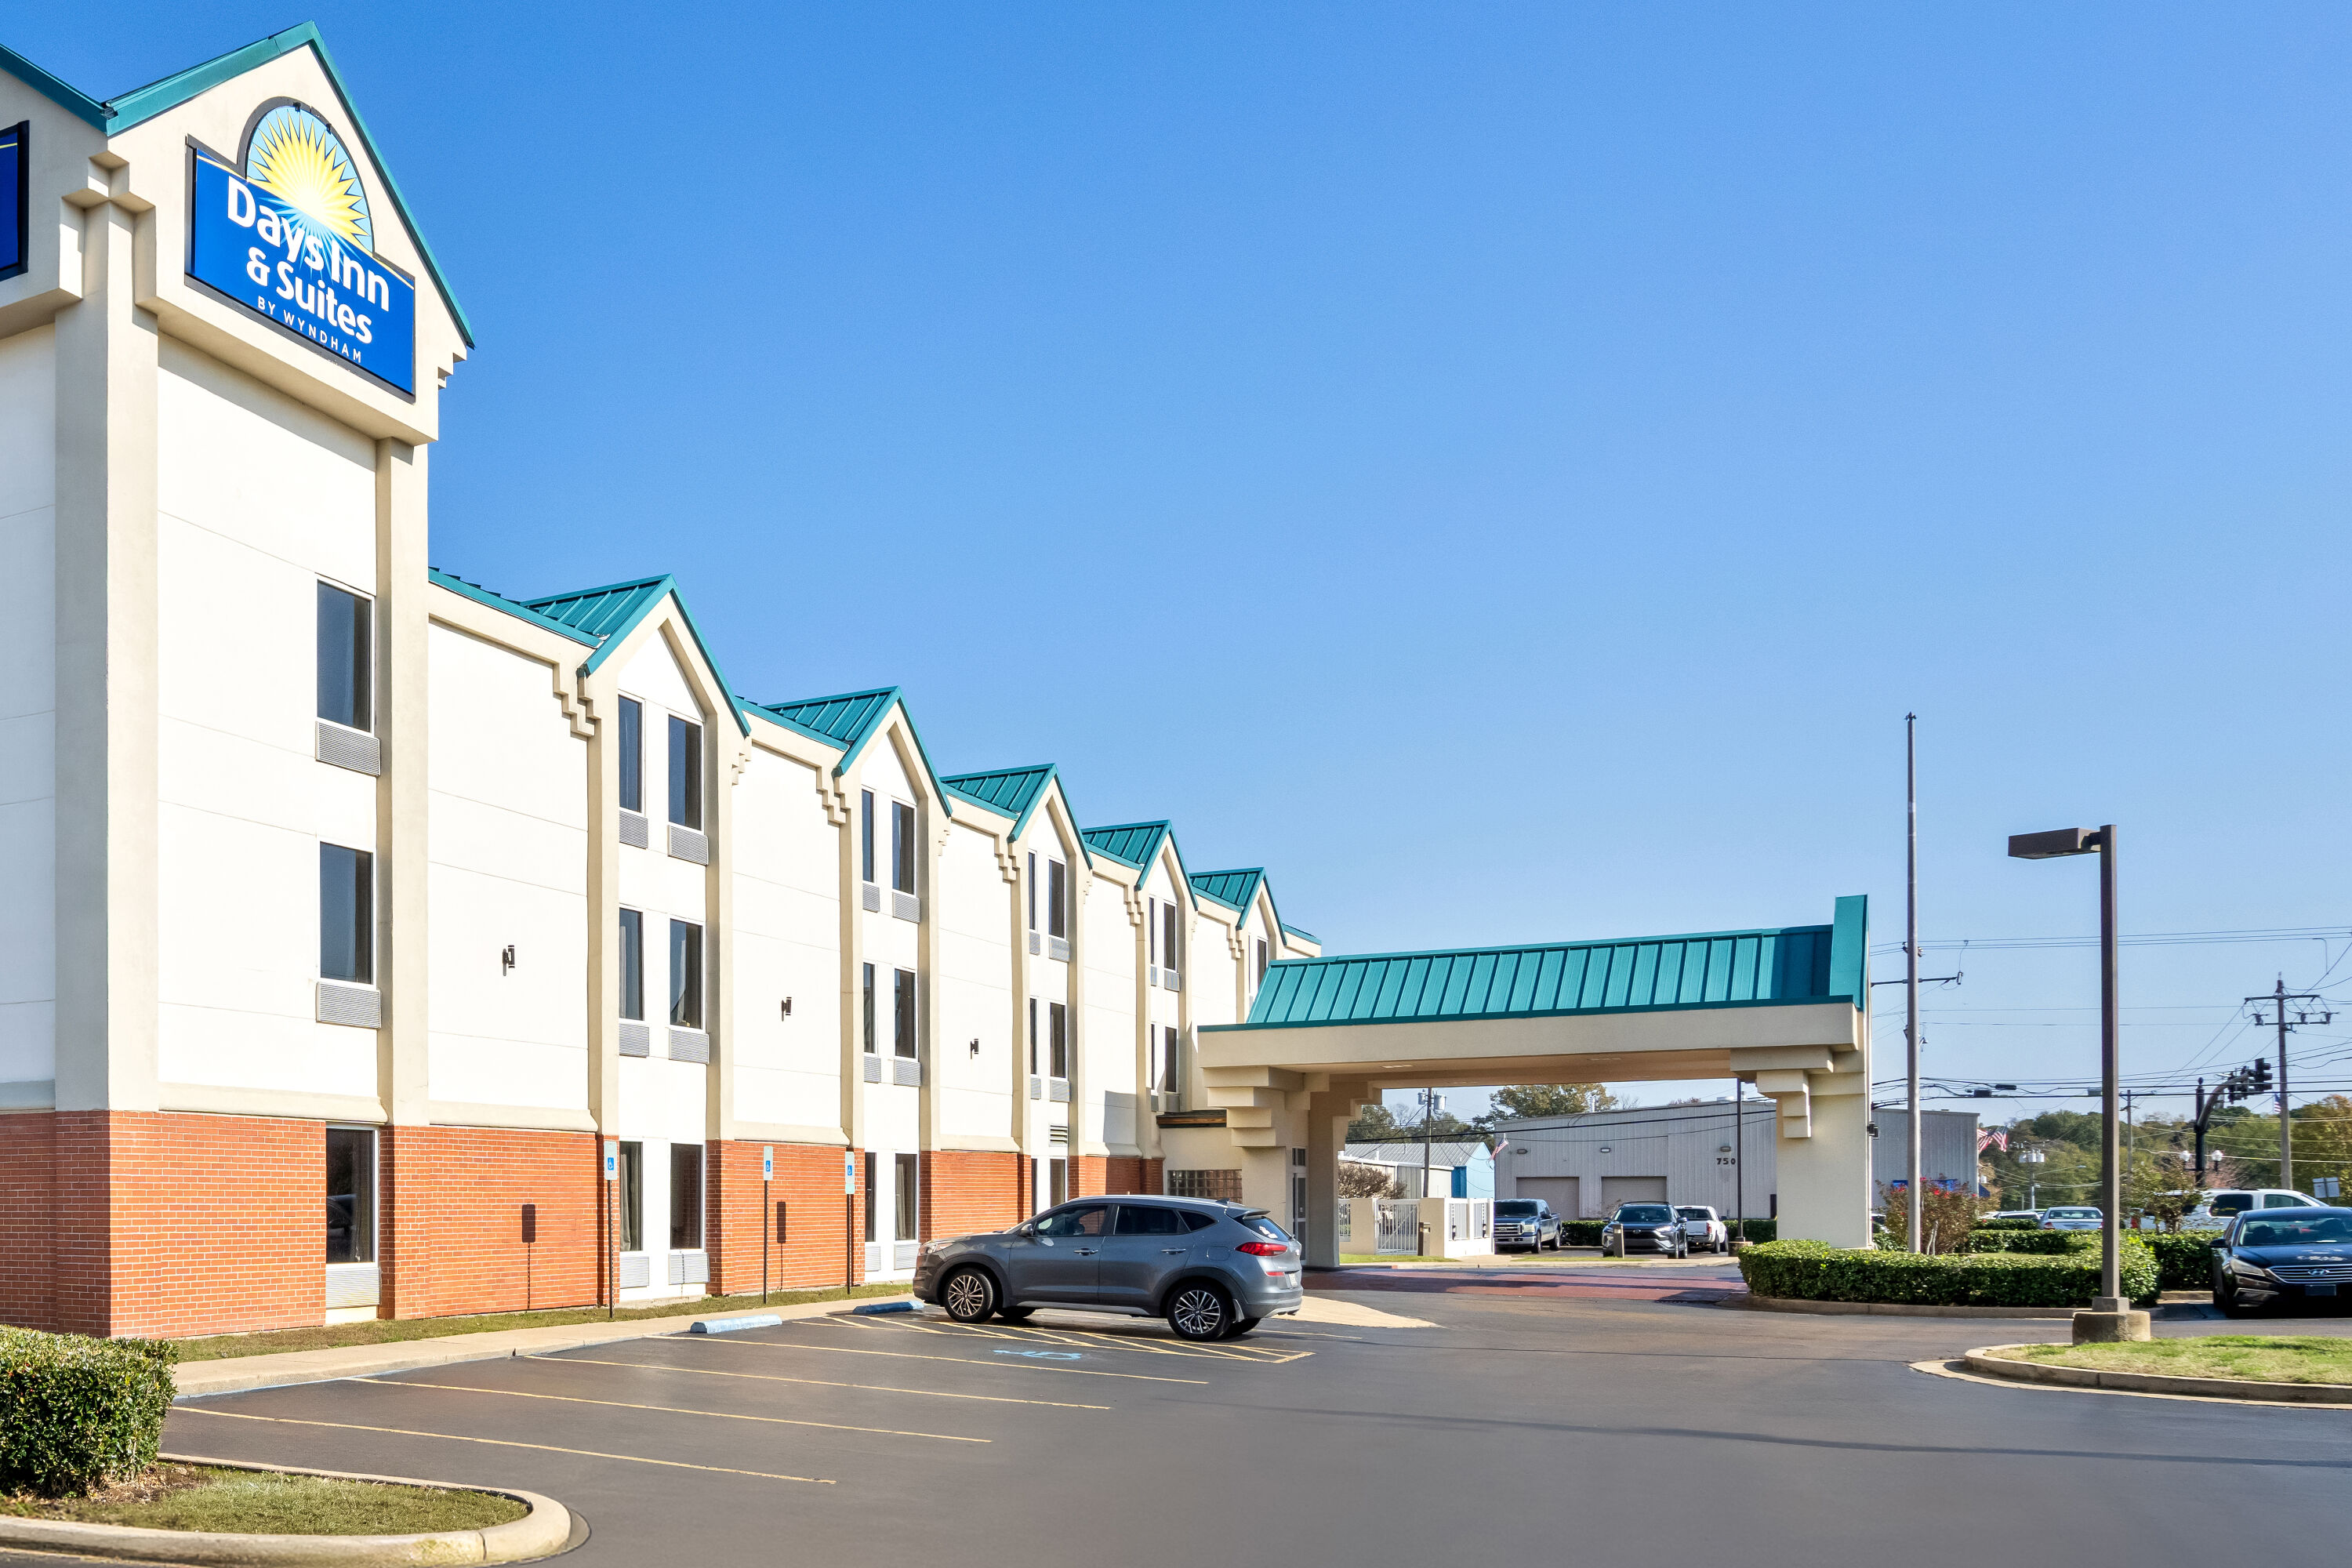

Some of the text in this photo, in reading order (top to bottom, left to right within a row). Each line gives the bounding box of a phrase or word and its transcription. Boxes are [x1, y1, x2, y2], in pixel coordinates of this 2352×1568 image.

[227, 176, 390, 312] Days Inn
[246, 246, 372, 344] & Suites
[258, 296, 361, 364] BY WYNDHAM
